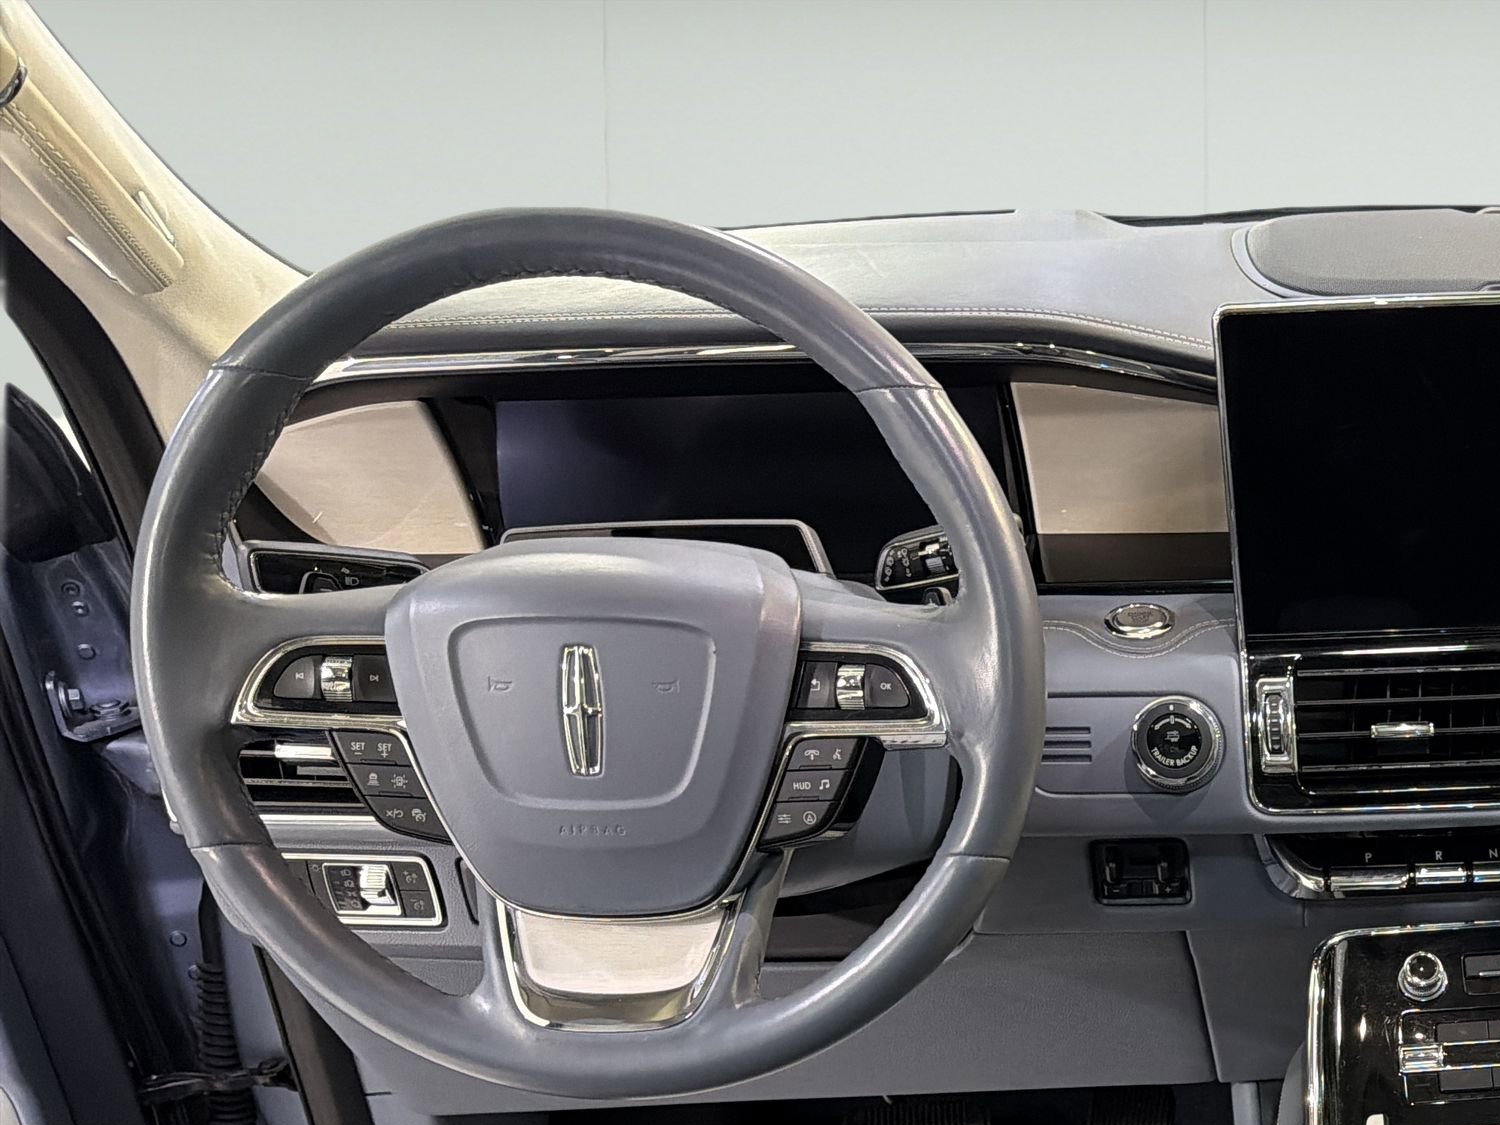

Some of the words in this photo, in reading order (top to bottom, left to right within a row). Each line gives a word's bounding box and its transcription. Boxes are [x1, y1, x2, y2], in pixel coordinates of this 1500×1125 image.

[879, 682, 892, 691] OK
[350, 741, 366, 751] SET
[377, 742, 393, 753] SET
[1150, 746, 1175, 767] TRAILER
[1175, 744, 1199, 767] BACKUP
[792, 781, 812, 791] HUD
[1364, 852, 1373, 863] P
[1435, 850, 1443, 861] R
[1488, 848, 1499, 859] N
